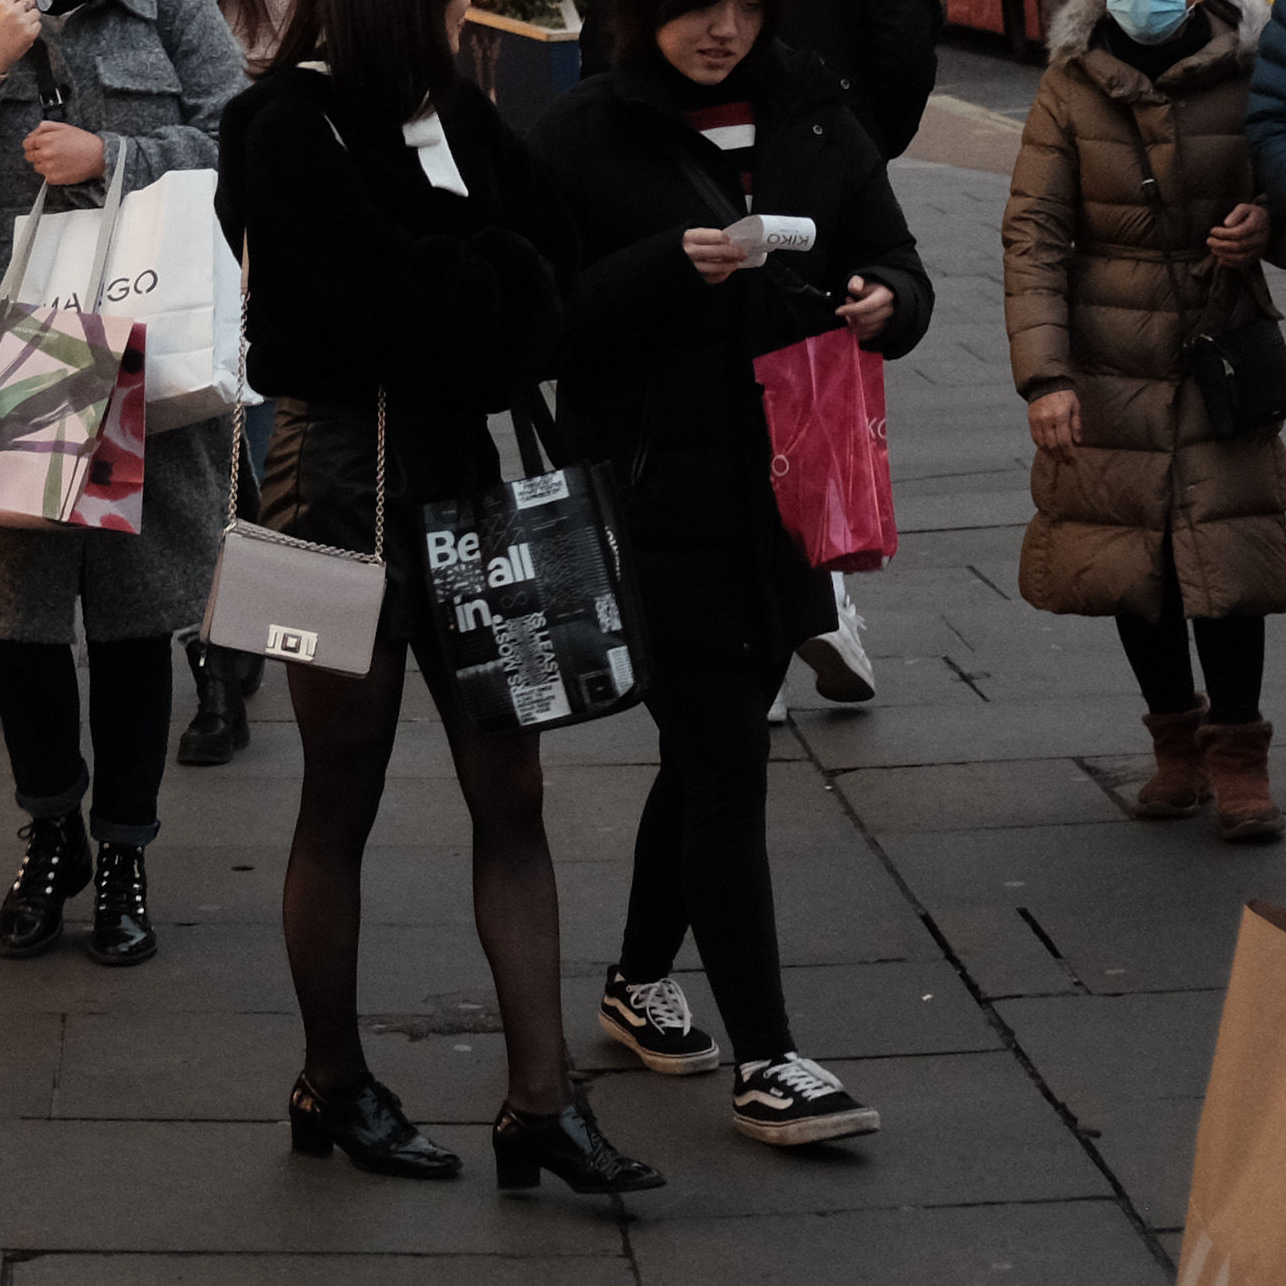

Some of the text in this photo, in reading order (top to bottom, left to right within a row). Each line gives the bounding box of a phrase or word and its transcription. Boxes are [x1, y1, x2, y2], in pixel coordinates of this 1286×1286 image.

[767, 234, 810, 246] KIKO
[426, 530, 481, 568] Be
[487, 543, 536, 588] all
